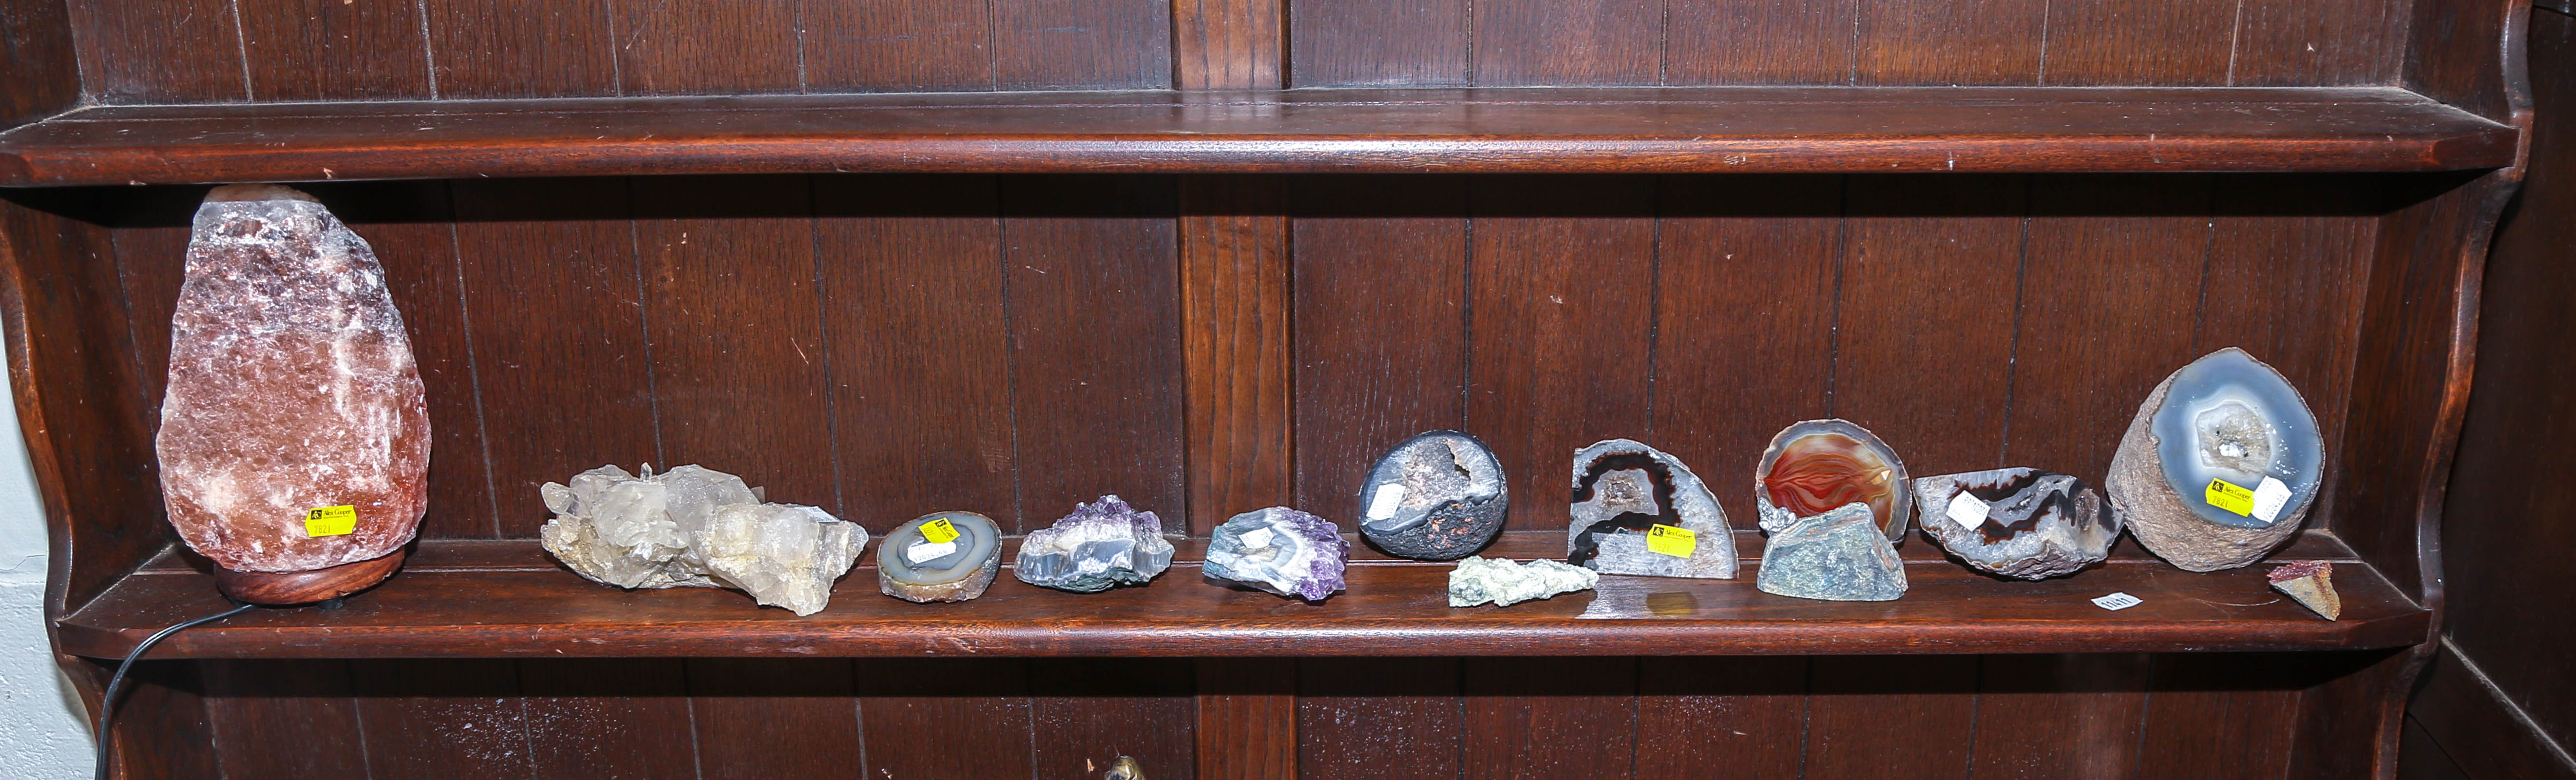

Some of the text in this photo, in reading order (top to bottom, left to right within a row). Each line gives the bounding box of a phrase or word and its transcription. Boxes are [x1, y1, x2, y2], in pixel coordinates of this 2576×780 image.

[2234, 489, 2251, 500] Cooper
[2213, 496, 2228, 507] 7821
[314, 525, 330, 534] 7821
[1676, 531, 1692, 539] Cooper
[1654, 542, 1670, 553] 7821
